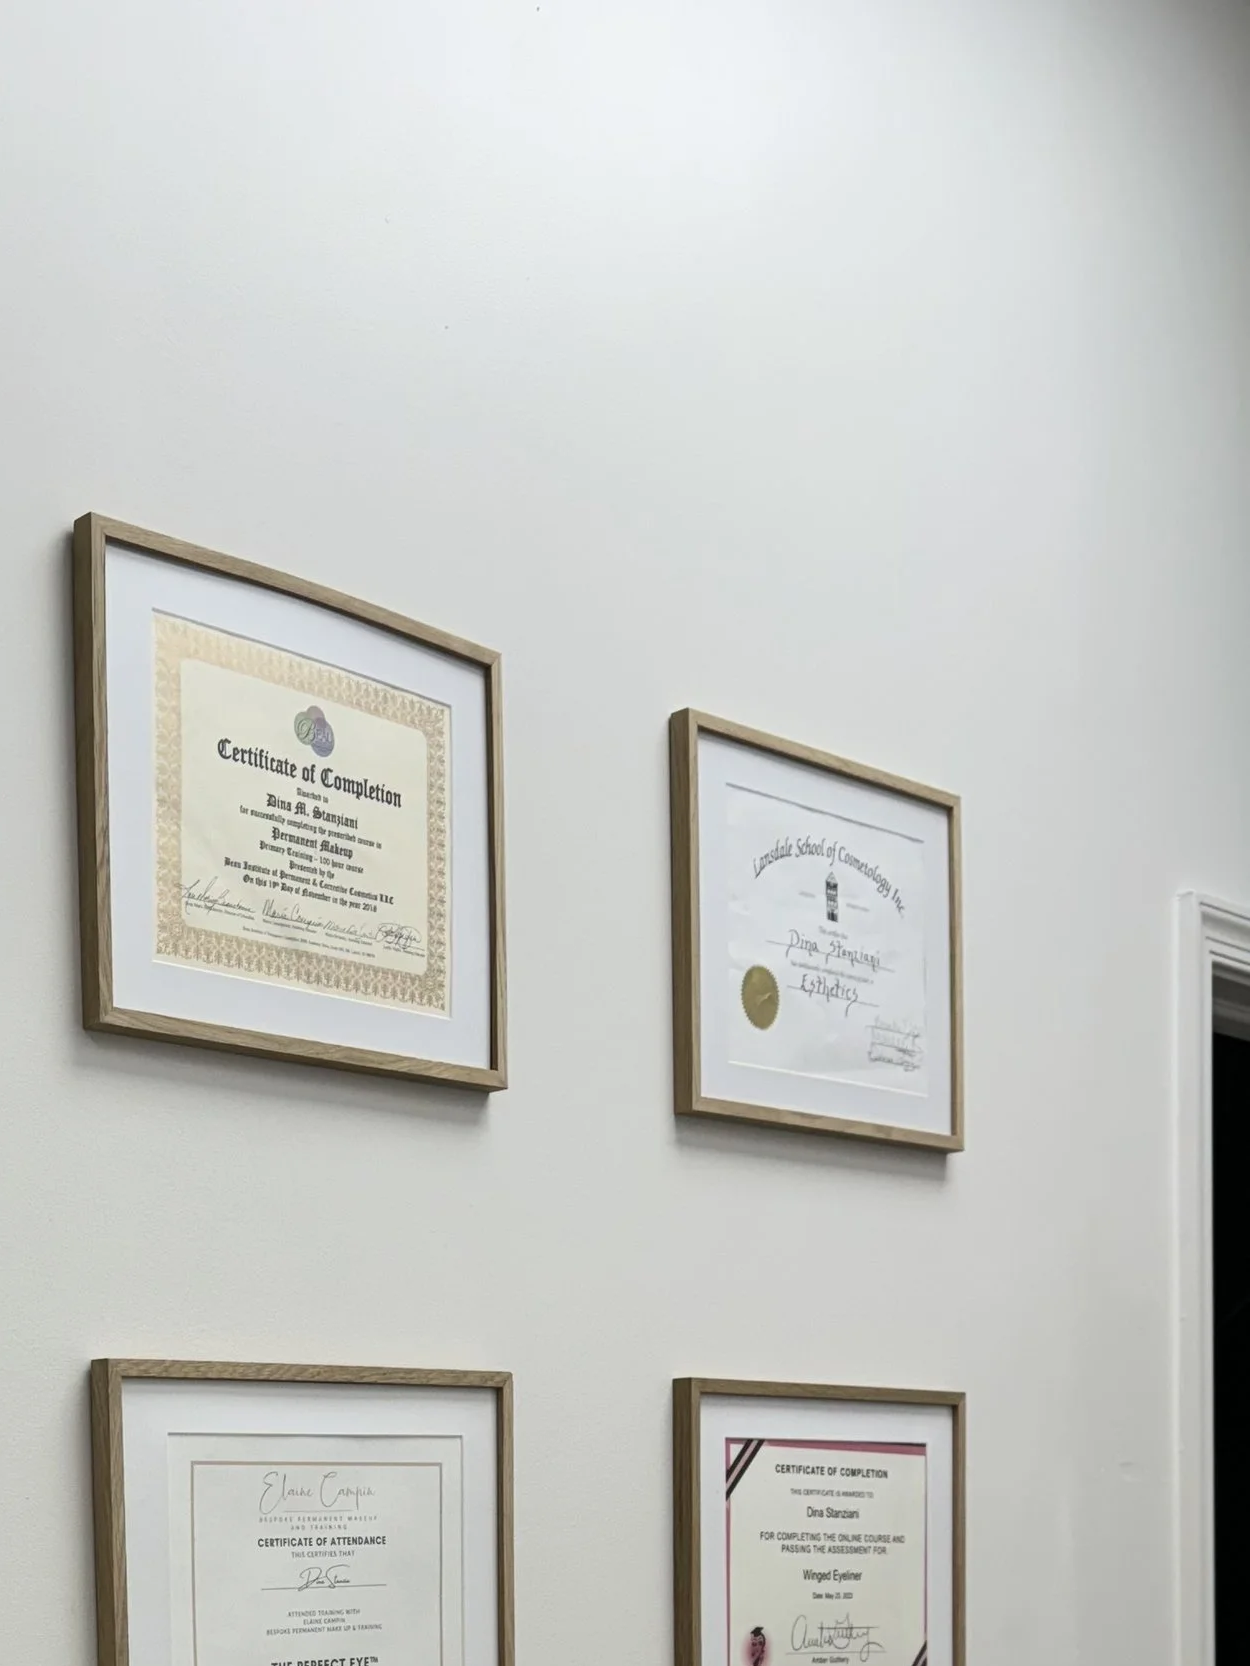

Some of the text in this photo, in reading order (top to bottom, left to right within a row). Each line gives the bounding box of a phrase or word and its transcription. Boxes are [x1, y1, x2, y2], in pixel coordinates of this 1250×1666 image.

[217, 737, 402, 809] Certificate of Completion
[266, 792, 358, 830] Dina M. Stanziani
[271, 826, 354, 860] Permanent Makeup
[753, 837, 793, 879] Lansdale
[795, 838, 826, 859] School
[826, 842, 838, 867] of
[838, 847, 891, 898] Cosmetology
[786, 928, 819, 958] Dina
[800, 974, 858, 1017] Esthetics
[774, 1463, 889, 1479] CERTIFICATE OF COMPLETION
[259, 1471, 314, 1514] Elaine
[806, 1505, 825, 1519] Dina
[257, 1535, 387, 1548] CERTIFICATE OF ATTENDANCE
[759, 1530, 776, 1541] FOR
[776, 1531, 822, 1542] COMPLETING
[822, 1532, 837, 1542] THE
[837, 1533, 863, 1543] ONLINE
[863, 1533, 892, 1544] COURSE
[291, 1549, 355, 1559] THIS CERTIFIES THAT
[780, 1543, 812, 1554] PASSING
[812, 1544, 827, 1555] THE
[826, 1545, 872, 1555] ASSESSMENT
[802, 1568, 863, 1584] Winged Eyeliner
